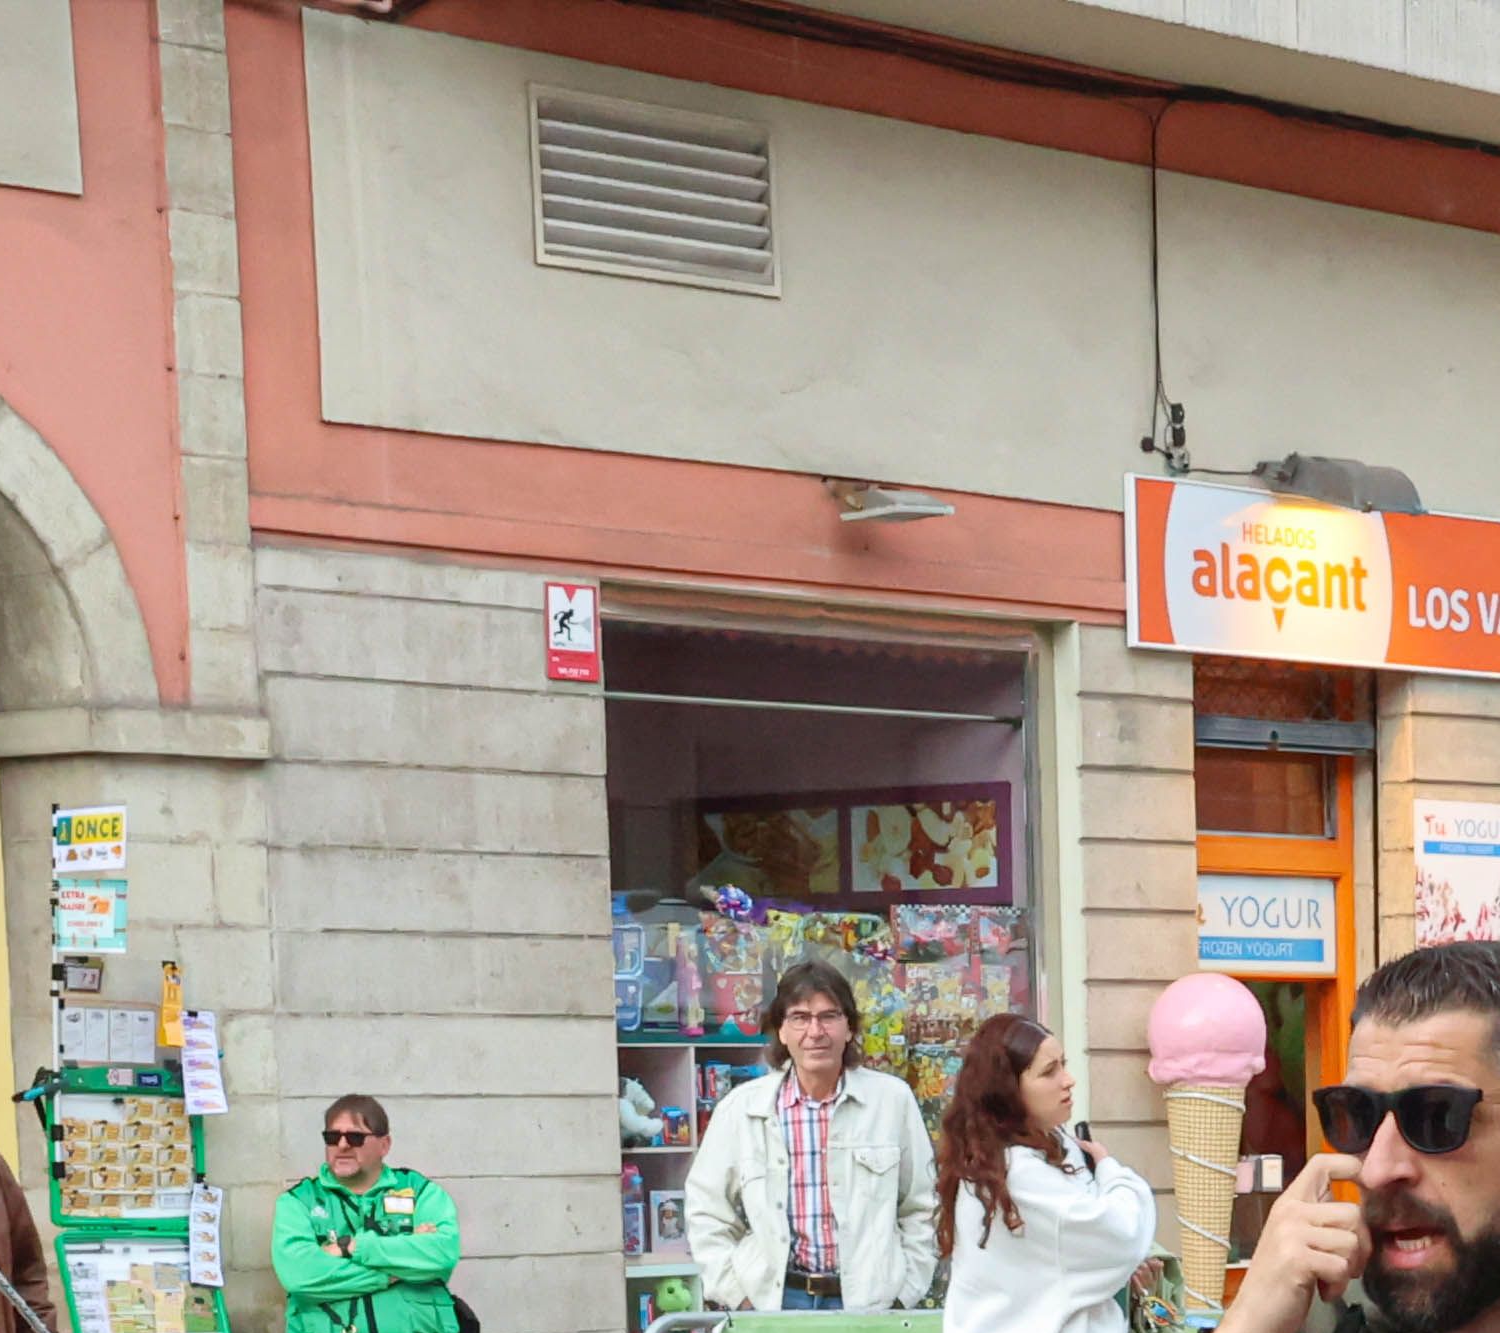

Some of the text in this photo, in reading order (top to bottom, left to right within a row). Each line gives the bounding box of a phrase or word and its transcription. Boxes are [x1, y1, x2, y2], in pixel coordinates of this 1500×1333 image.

[1241, 521, 1317, 550] HELADOS
[1191, 541, 1369, 624] alaçant
[1408, 585, 1472, 635] LOS
[75, 816, 121, 840] ONCE
[1424, 814, 1446, 837] Tu
[1219, 895, 1323, 930] YOGUR
